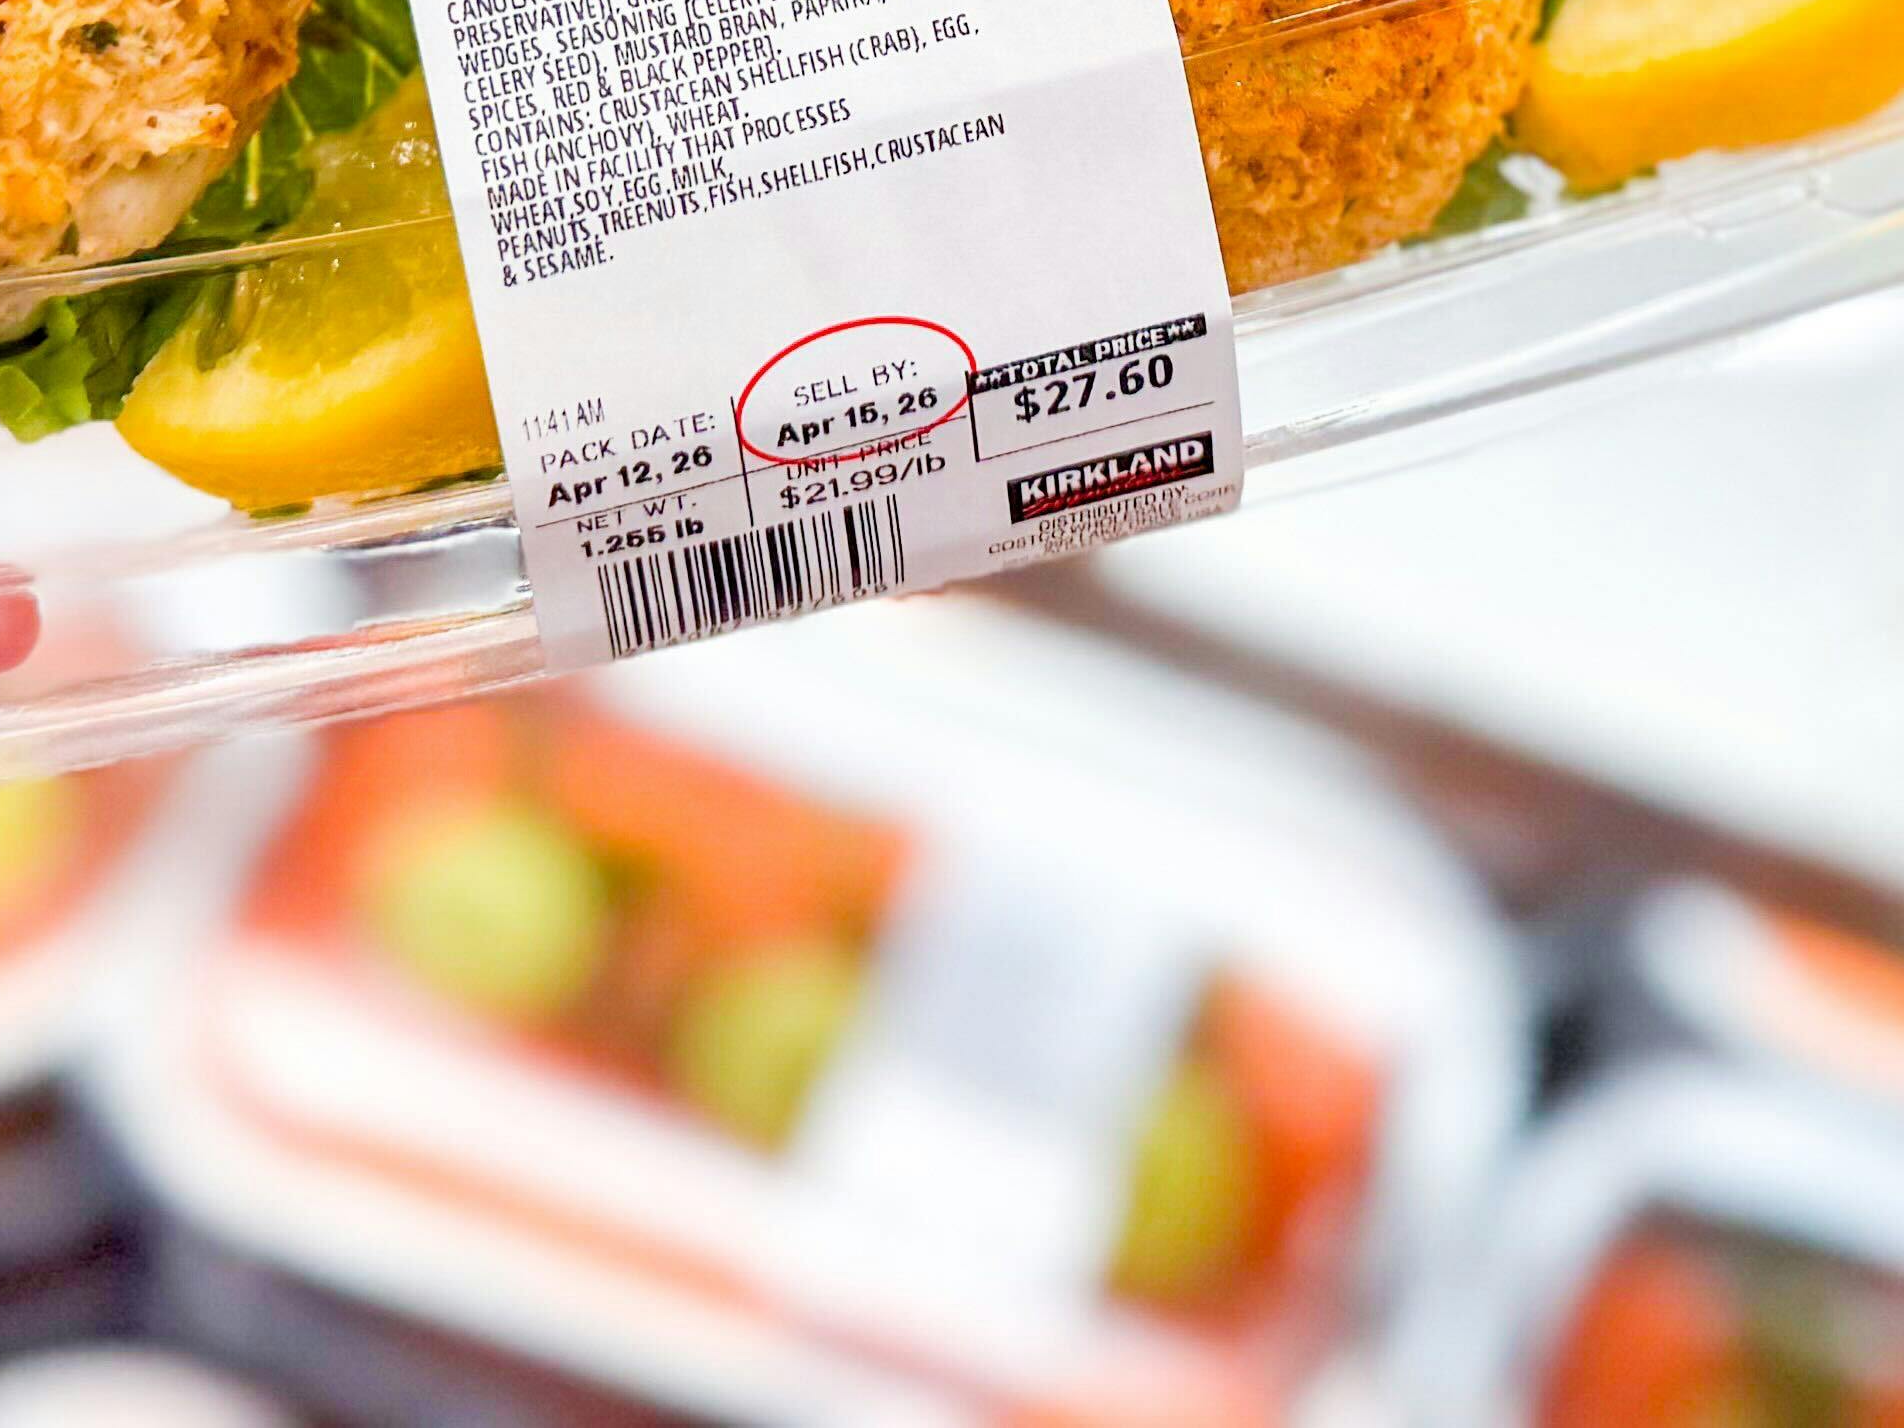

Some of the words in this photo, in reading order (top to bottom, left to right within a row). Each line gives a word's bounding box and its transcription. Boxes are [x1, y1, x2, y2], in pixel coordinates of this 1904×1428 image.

[474, 107, 594, 157] CONTAINS:
[598, 70, 733, 126] CRUSTACEAN
[736, 43, 845, 92] SHELLFISH
[480, 150, 529, 184] FISH
[486, 172, 549, 211] MADE
[554, 164, 582, 194] IN
[586, 139, 676, 185] FACILITY
[680, 125, 735, 160] THAT
[741, 96, 852, 146] PROCESSES
[502, 263, 518, 288] &
[574, 396, 607, 428] AM
[794, 375, 858, 408] SELL
[871, 358, 917, 387] BY:
[1012, 353, 1174, 424] $27.60
[539, 437, 616, 472] PACK
[631, 412, 716, 451] DATE:
[776, 414, 837, 450] Apr
[843, 402, 889, 432] 15,
[897, 385, 939, 415] 26
[548, 473, 608, 510] Apr
[618, 462, 665, 490] 12,
[668, 445, 713, 475] 26
[858, 431, 934, 465] PRICE
[1020, 439, 1207, 505] KIRKLAND
[779, 452, 946, 511] $21.99/lb
[576, 510, 625, 537] NET
[643, 491, 698, 519] WT.
[578, 523, 667, 561] 1.255
[673, 517, 705, 540] lb
